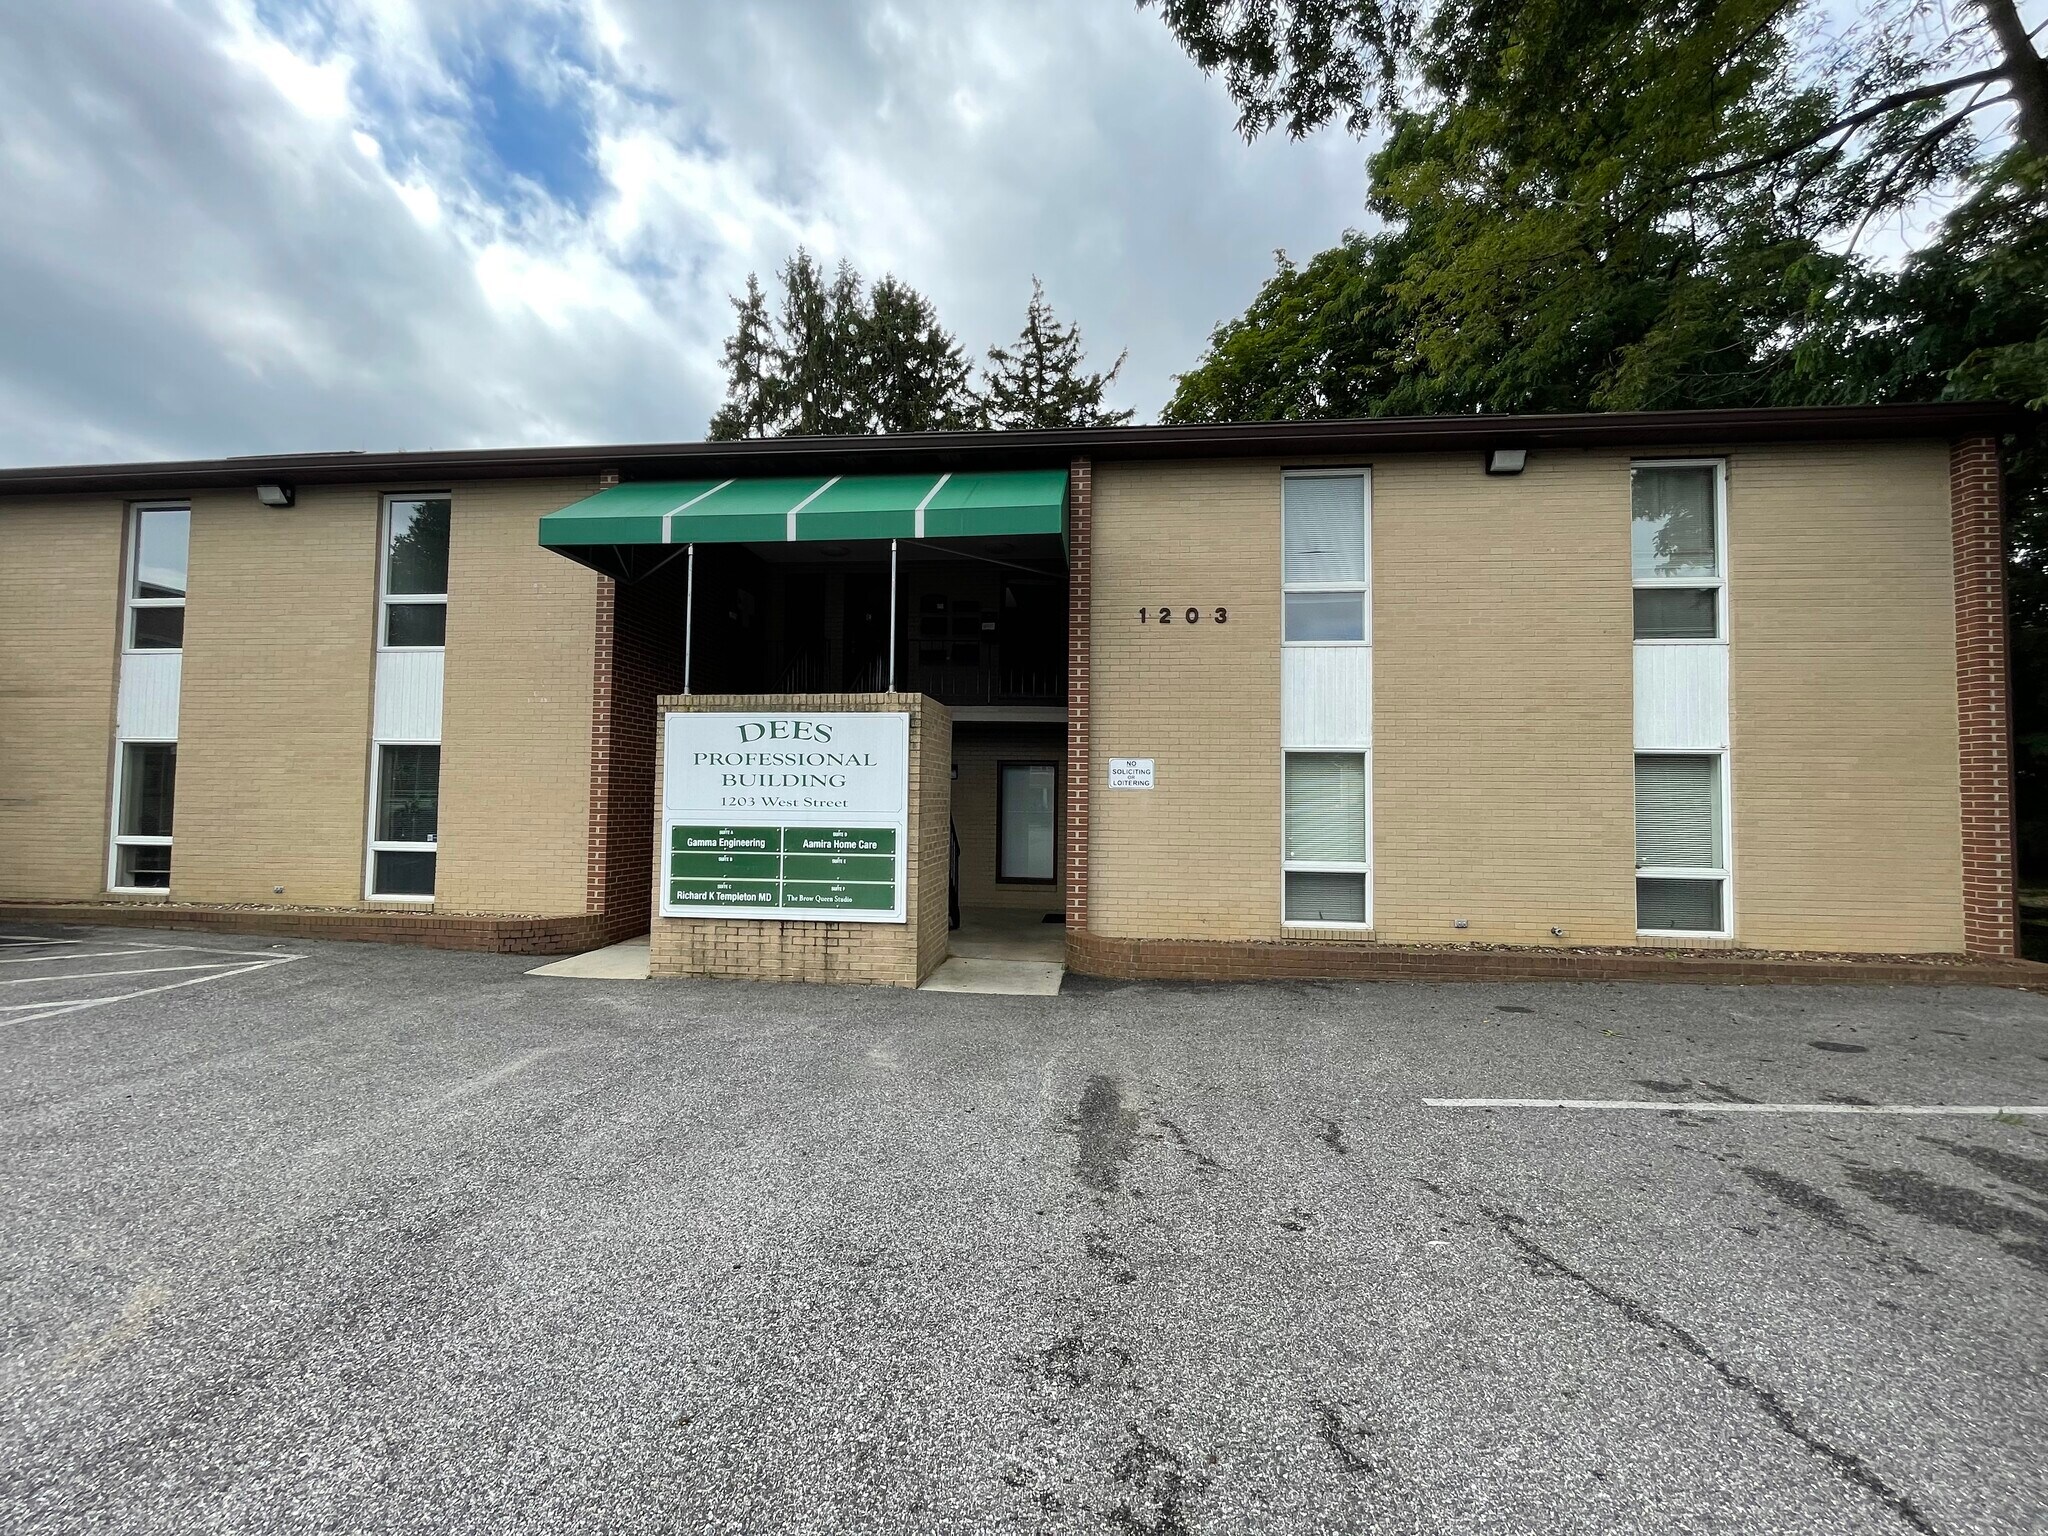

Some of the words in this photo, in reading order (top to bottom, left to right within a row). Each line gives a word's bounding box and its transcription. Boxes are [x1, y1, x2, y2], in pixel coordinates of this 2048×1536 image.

[1139, 607, 1227, 624] 1203
[736, 720, 833, 744] DEES
[693, 752, 878, 767] PROFESSIONAL
[721, 773, 847, 788] BUILDING
[721, 796, 756, 807] 1203
[761, 797, 798, 808] West
[803, 796, 849, 808] Street
[687, 838, 717, 847] Gamma
[719, 838, 766, 849] Engineering
[803, 839, 831, 849] Aamira
[833, 839, 857, 849] Home
[858, 840, 877, 849] Care
[677, 891, 707, 900] Richard
[709, 892, 715, 900] K
[717, 892, 757, 902] Templeton
[758, 893, 772, 901] MD
[815, 895, 833, 903] Queen
